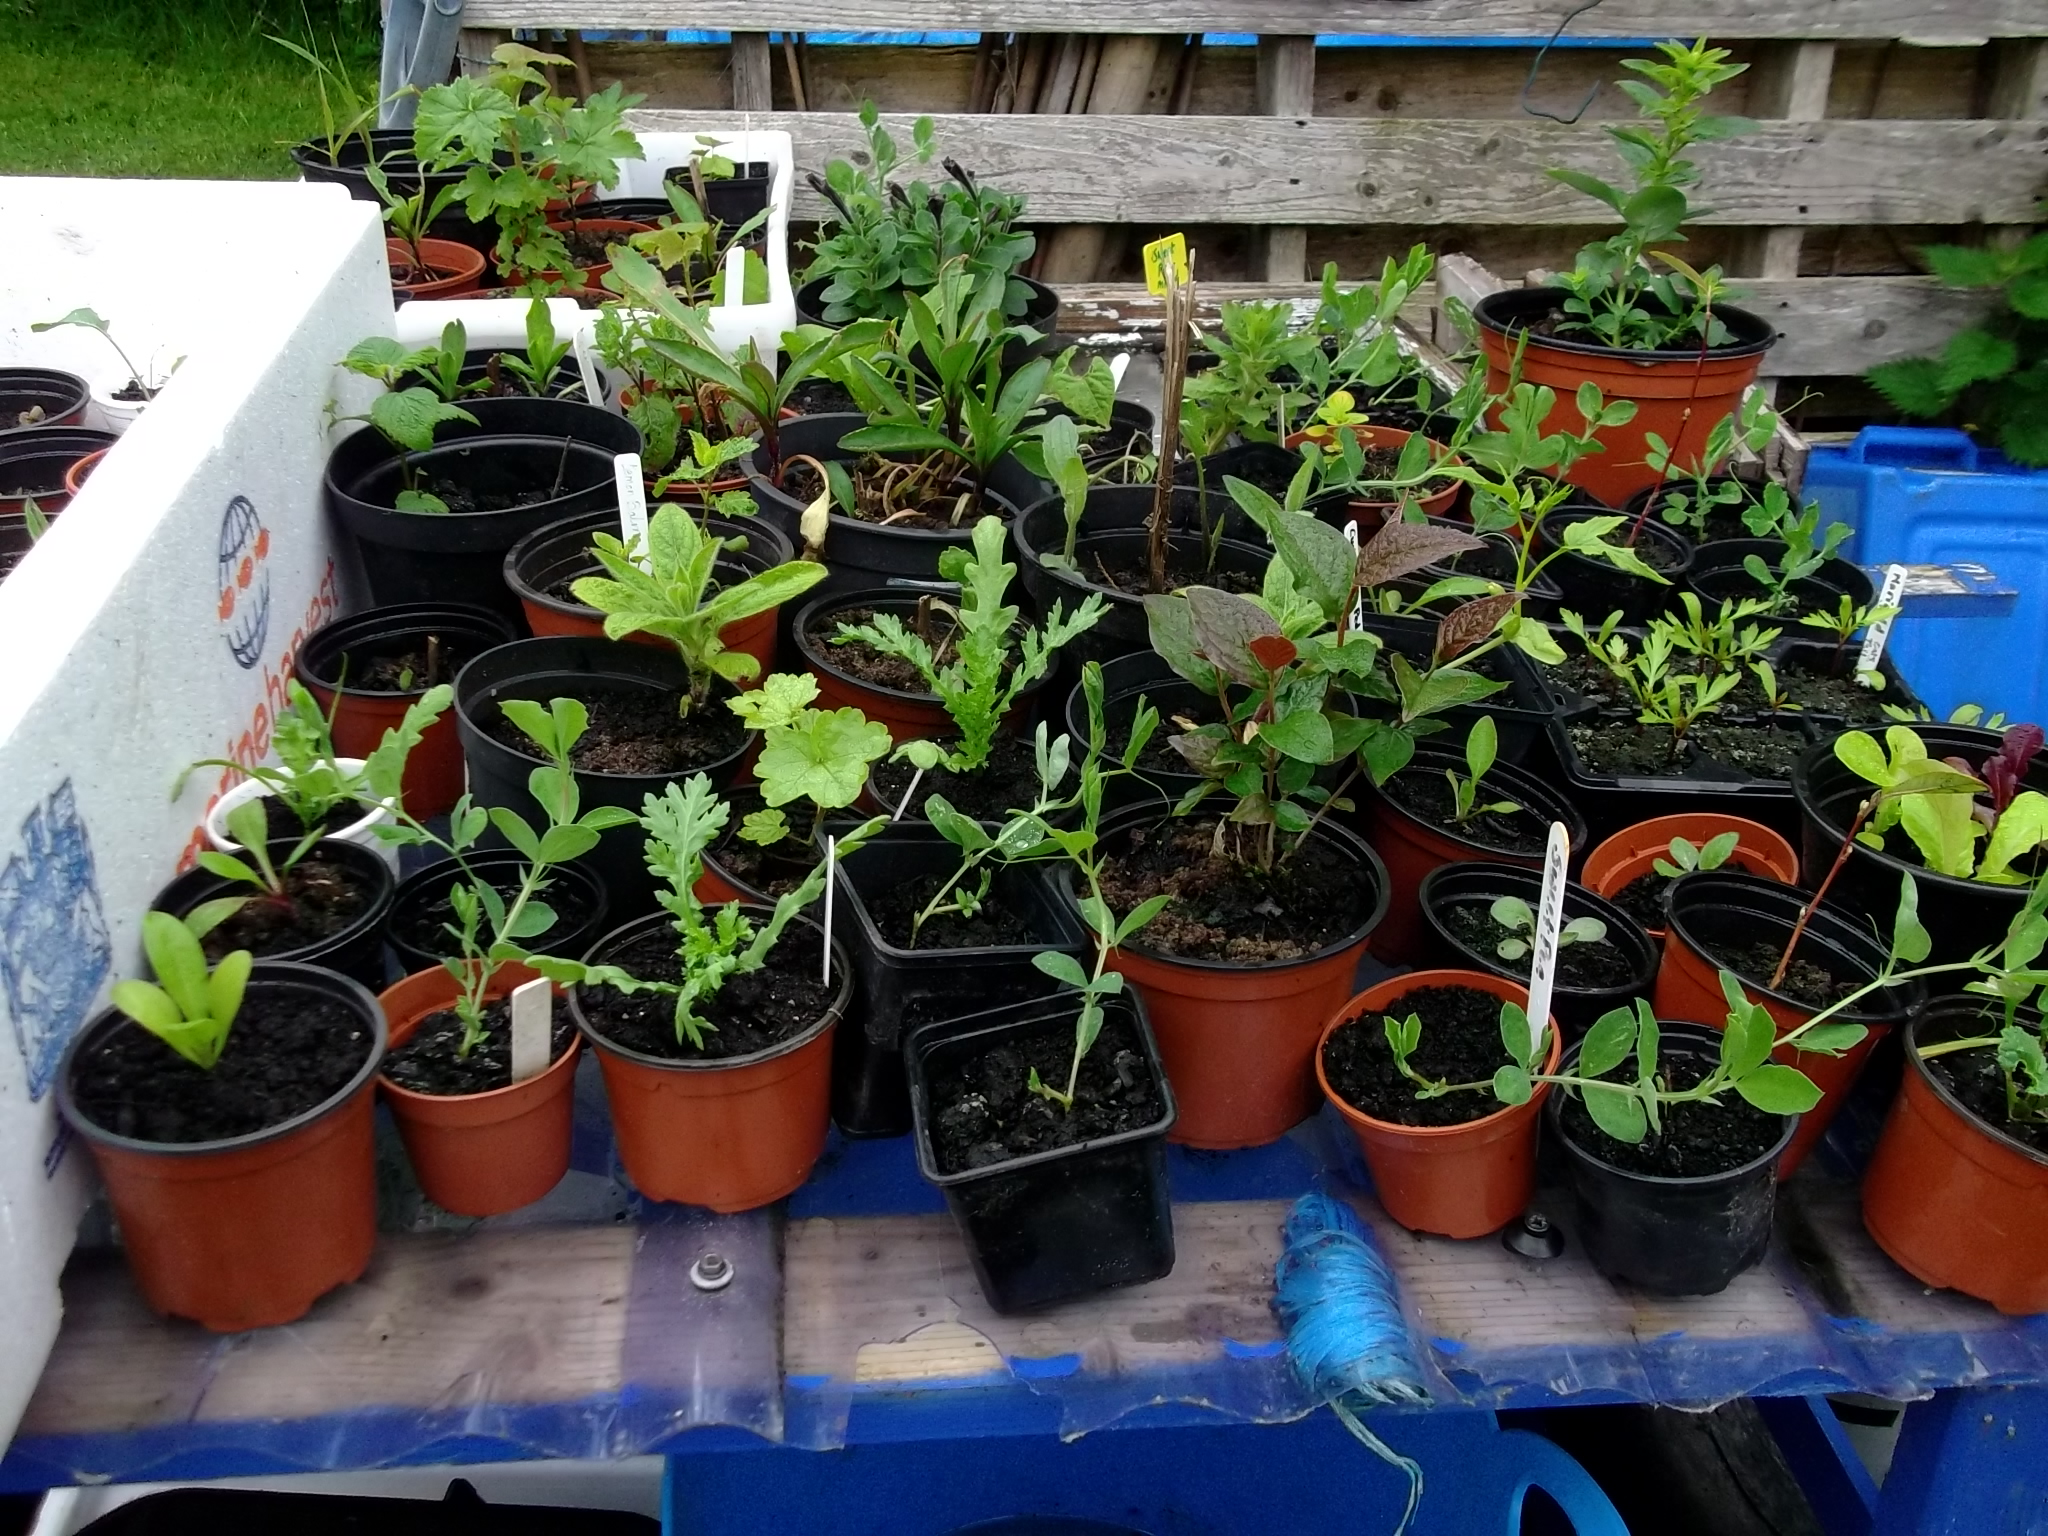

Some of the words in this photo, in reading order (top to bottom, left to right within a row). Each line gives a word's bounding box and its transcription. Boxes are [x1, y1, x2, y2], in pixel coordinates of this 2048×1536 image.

[620, 464, 638, 495] Lemon
[1542, 843, 1562, 935] Sweet
[1537, 933, 1552, 981] Pea
